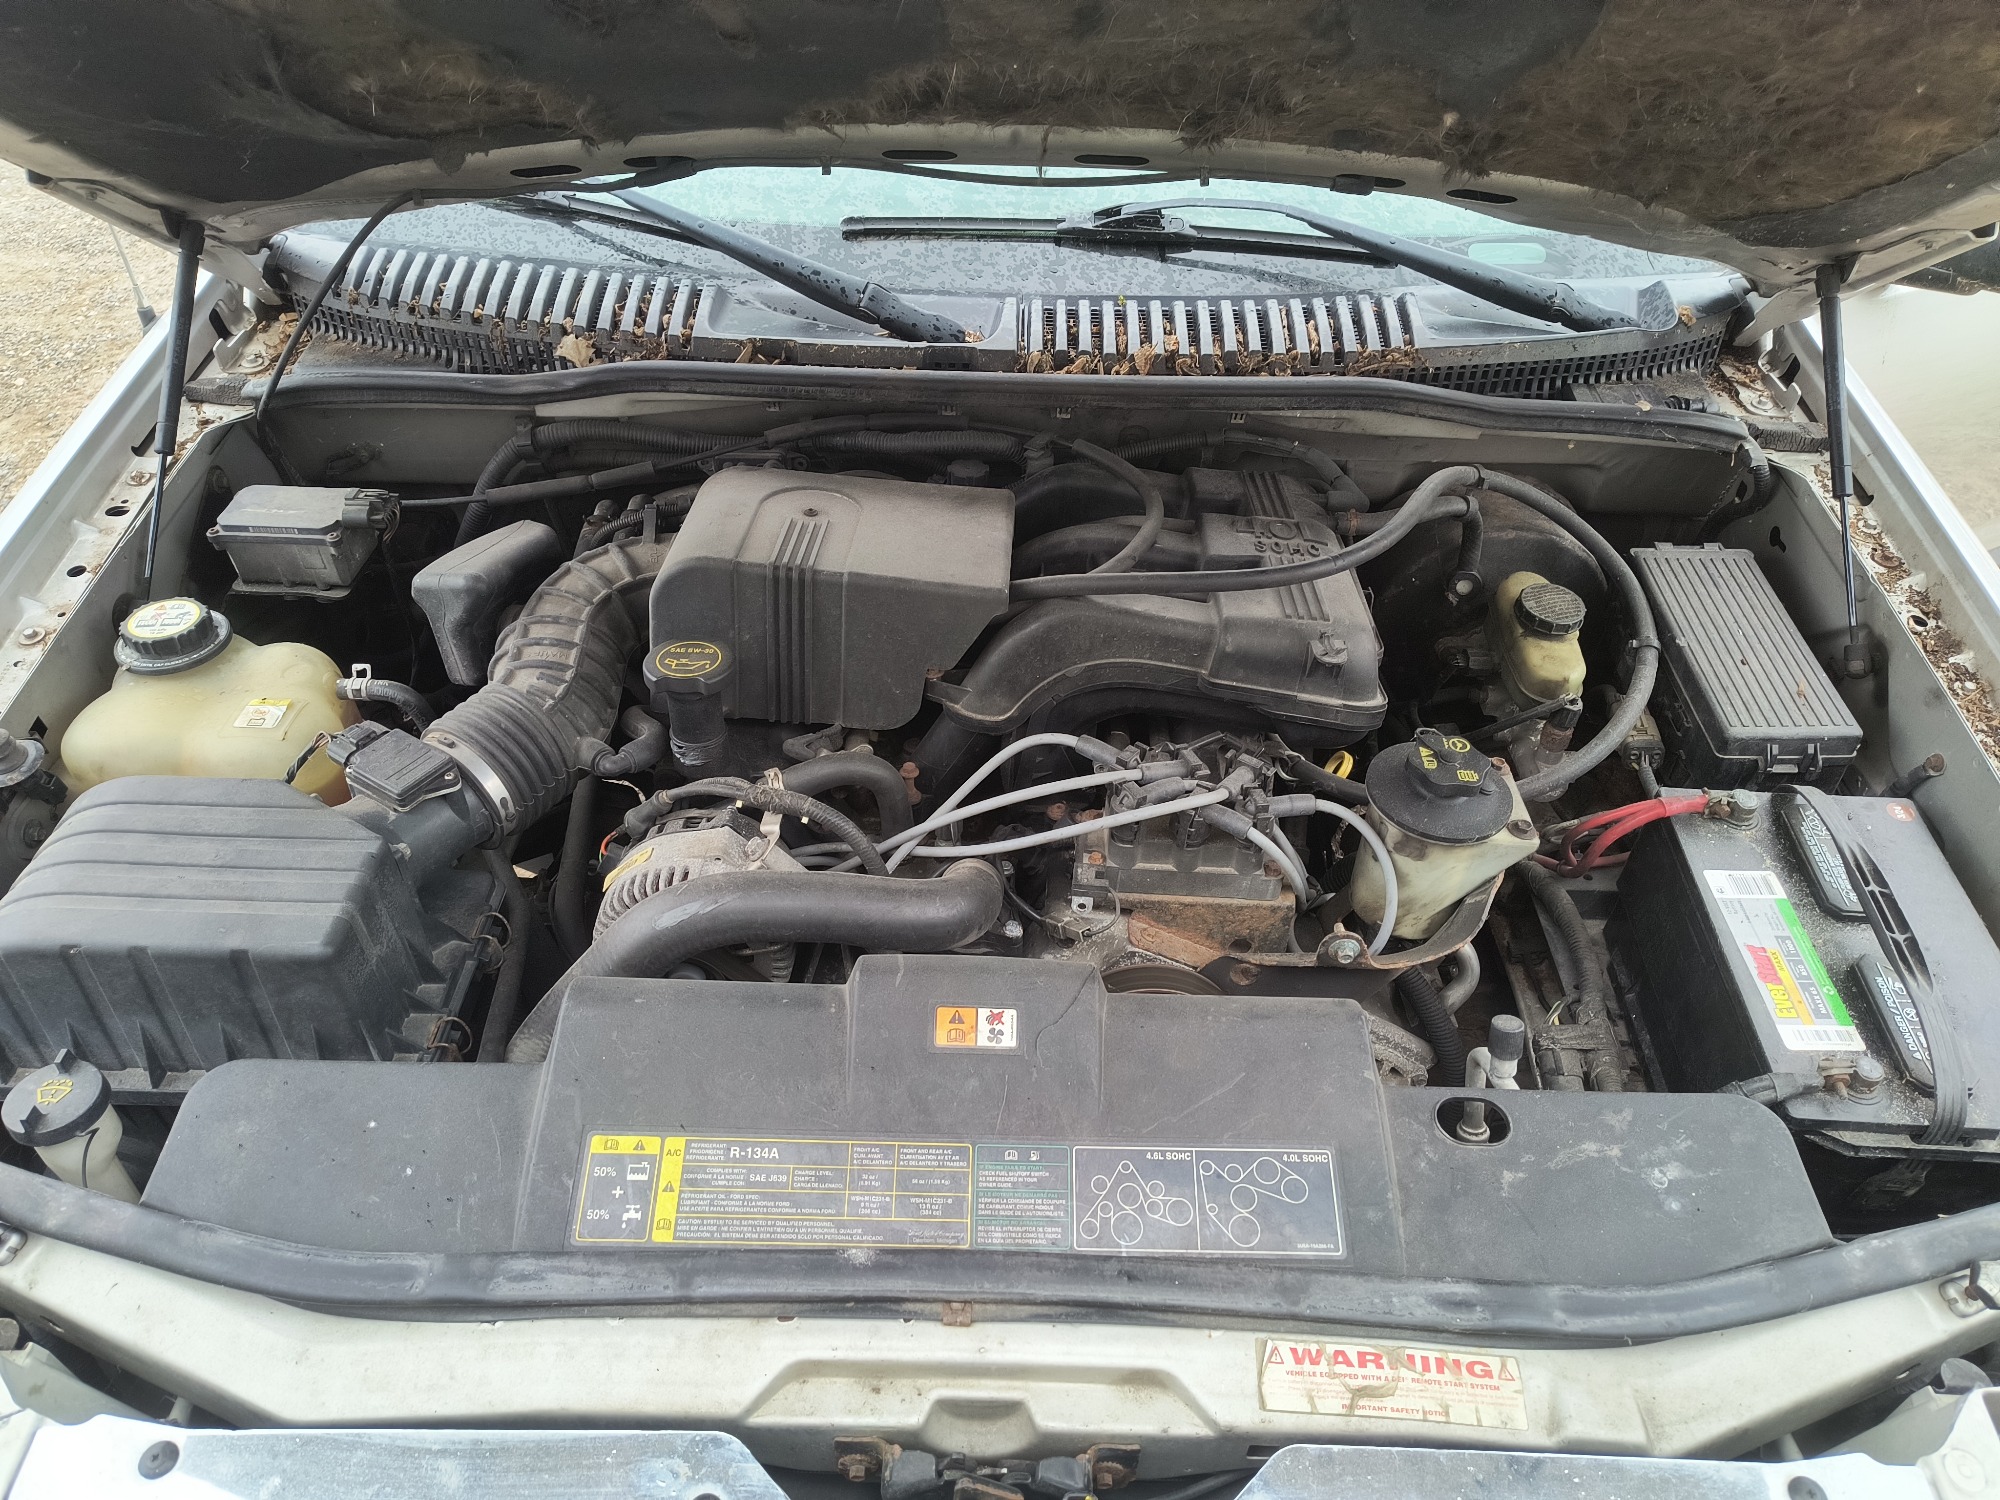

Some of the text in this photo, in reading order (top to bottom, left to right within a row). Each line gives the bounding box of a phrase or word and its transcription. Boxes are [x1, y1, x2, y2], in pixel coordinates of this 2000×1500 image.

[1254, 539, 1321, 557] SOHC
[1770, 951, 1786, 972] MAXX
[1744, 944, 1798, 1018] EverStart
[1874, 977, 1896, 1008] POISON
[1814, 995, 1828, 1014] MAXX
[1894, 1016, 1918, 1050] DANGER
[730, 1147, 779, 1159] R-134A
[594, 1166, 616, 1177] 50%
[586, 1208, 610, 1220] 50%
[1286, 1370, 1317, 1378] VEHICLE
[1470, 1382, 1500, 1391] SYSTEM
[1342, 1404, 1449, 1417] IMORTANT SAFETY NOTIC
